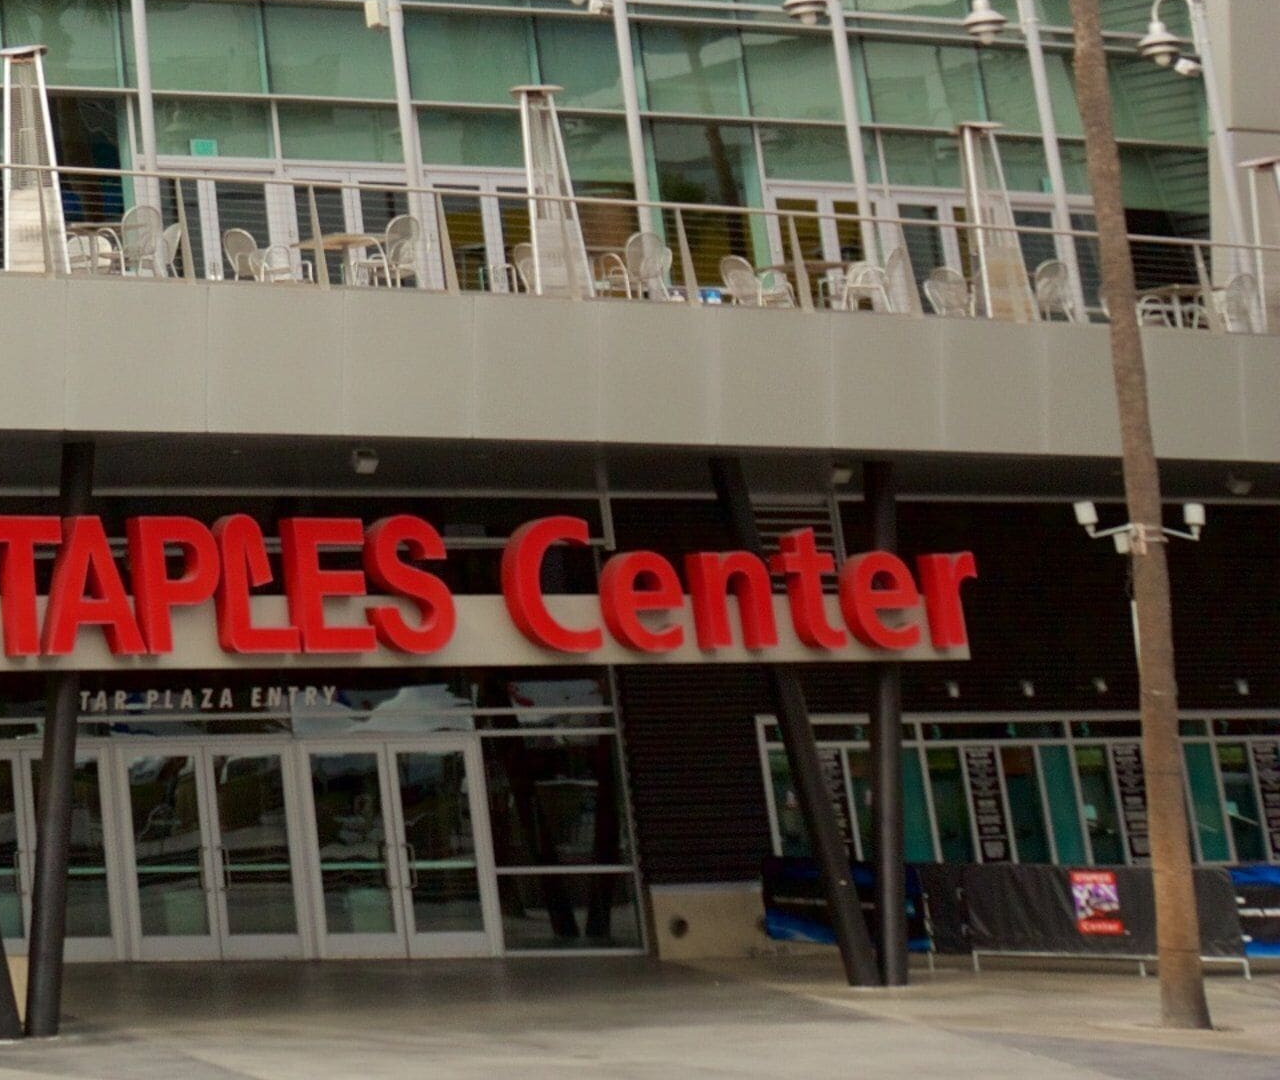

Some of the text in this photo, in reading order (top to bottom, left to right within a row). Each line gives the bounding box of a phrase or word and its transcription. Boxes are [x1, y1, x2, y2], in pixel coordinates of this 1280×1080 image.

[500, 515, 977, 656] Center
[79, 684, 338, 712] TAR PLAZA ENTRY
